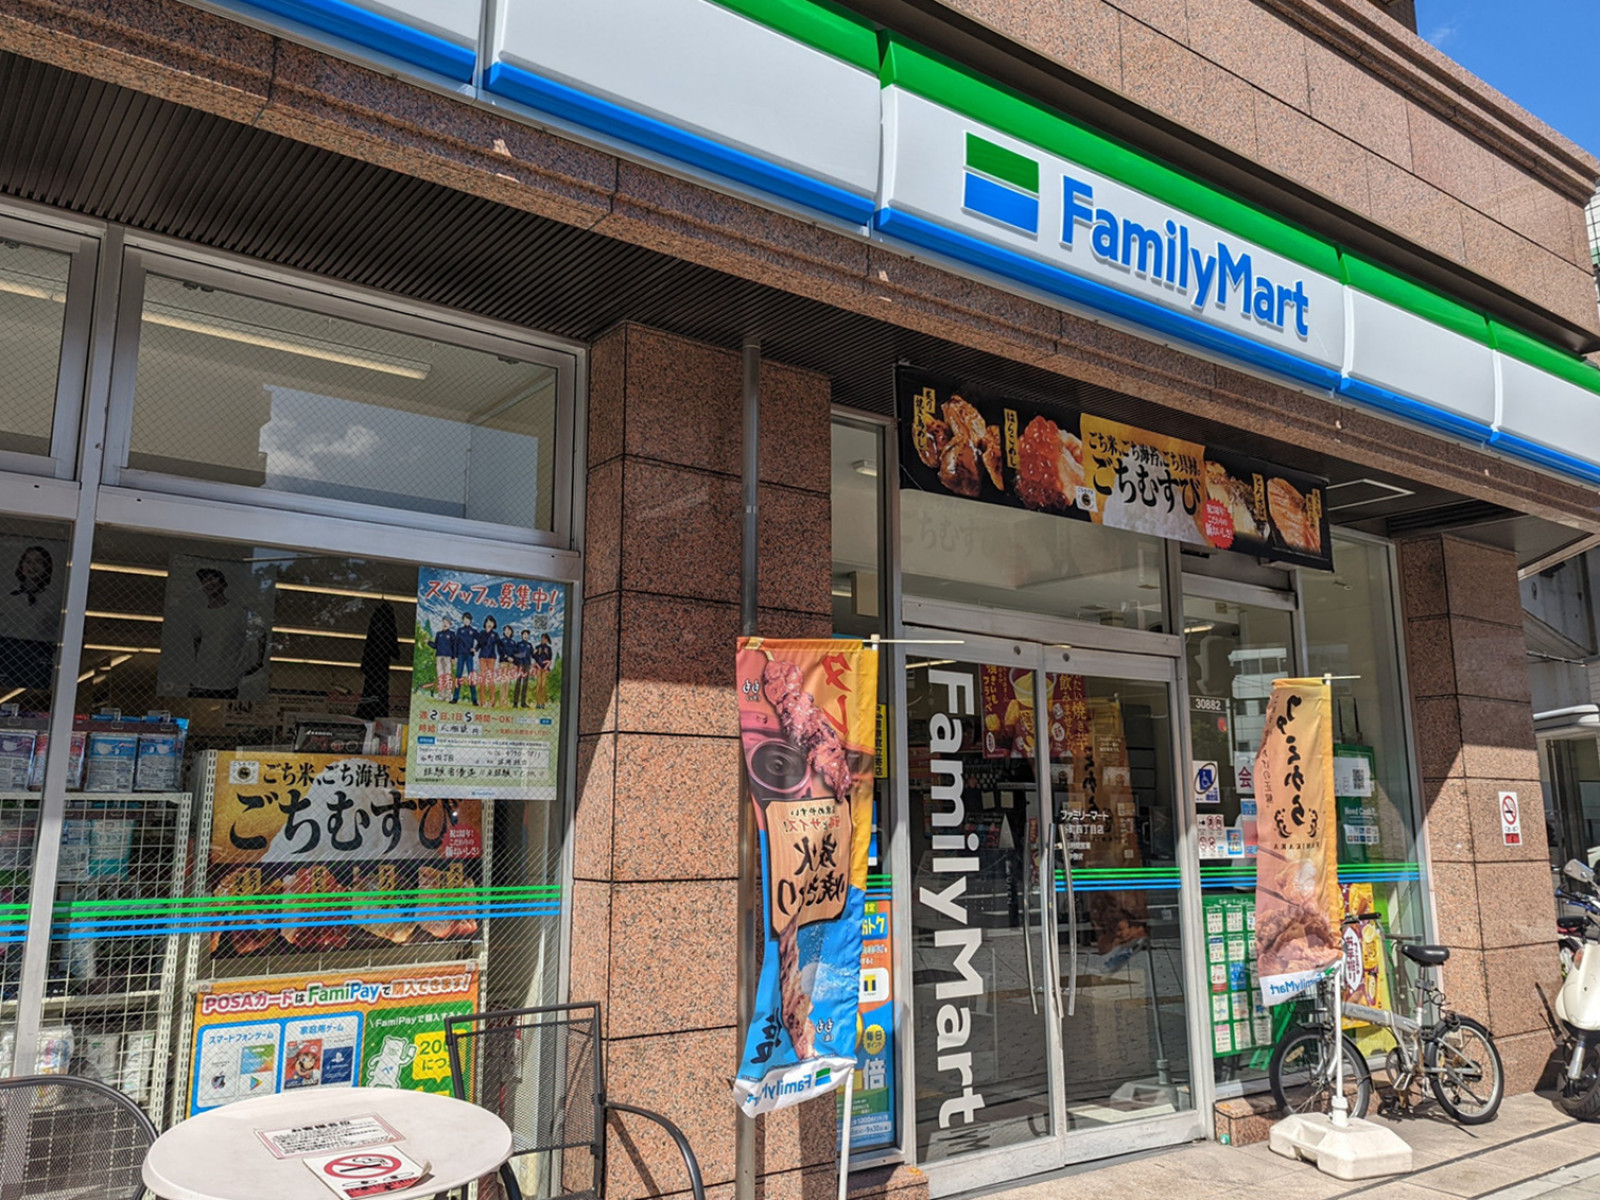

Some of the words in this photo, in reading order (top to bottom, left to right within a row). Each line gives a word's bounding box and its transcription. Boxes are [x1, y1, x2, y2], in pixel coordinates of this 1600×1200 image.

[1060, 174, 1309, 336] FamilyMart
[1091, 454, 1202, 516] ごちむすび
[1072, 674, 1089, 751] たい焼き芋
[1195, 698, 1222, 711] 30882
[229, 787, 461, 855] ごちむすび
[1060, 810, 1110, 821] ファミリーマート
[1064, 824, 1105, 835] 町四丁目店
[919, 668, 986, 1130] FamilyMart
[209, 1030, 274, 1045] スマートフォンゲーム
[420, 1039, 449, 1056] 20
[422, 1057, 451, 1072] につ
